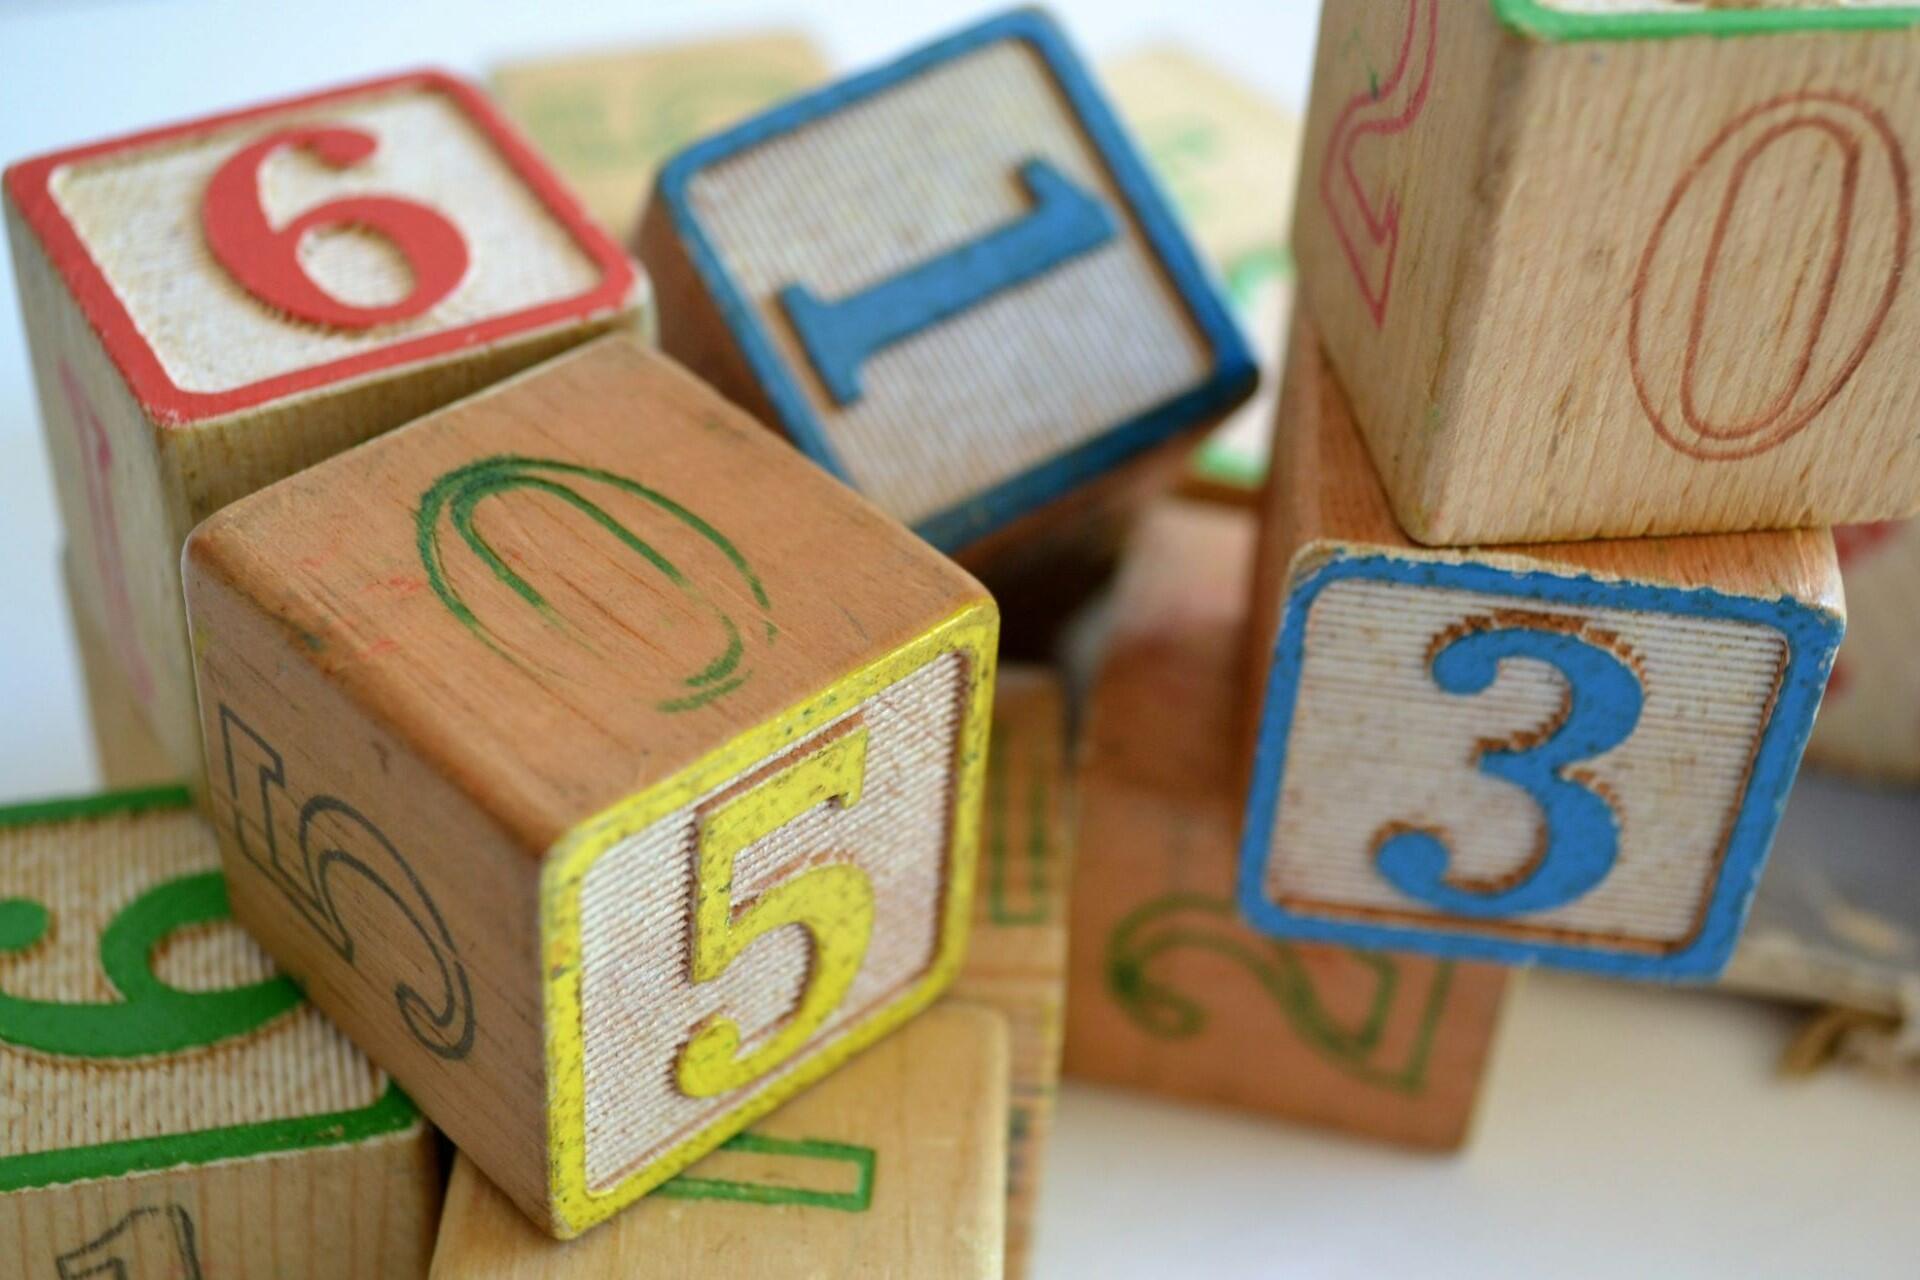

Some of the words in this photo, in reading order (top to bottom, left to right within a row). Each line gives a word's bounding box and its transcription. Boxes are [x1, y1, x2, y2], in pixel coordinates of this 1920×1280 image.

[202, 126, 470, 329] 6
[781, 157, 1117, 405] 1
[1627, 86, 1911, 461] 0
[219, 702, 476, 1059] 5
[677, 725, 877, 1098] 5
[1375, 625, 1645, 917] 3
